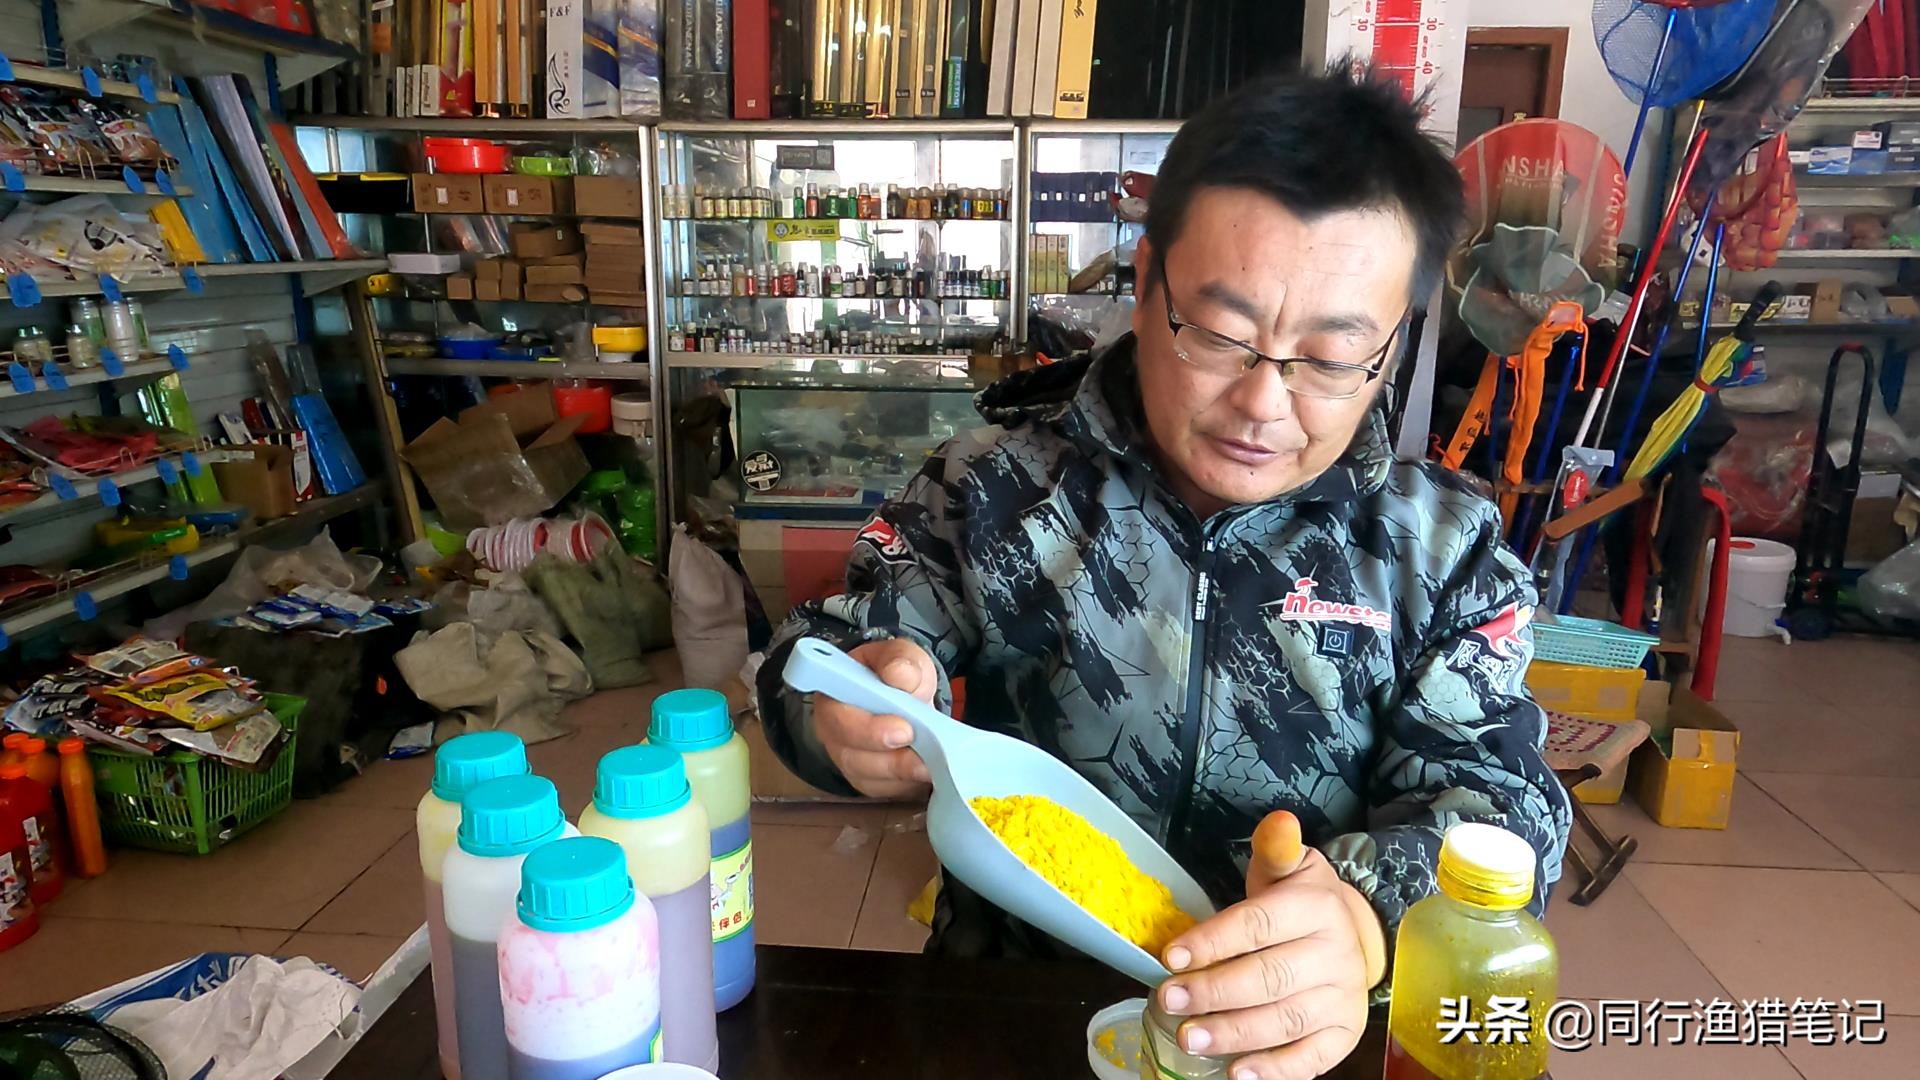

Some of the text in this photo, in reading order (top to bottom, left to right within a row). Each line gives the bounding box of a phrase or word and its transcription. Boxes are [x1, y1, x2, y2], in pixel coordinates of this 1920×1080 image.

[1357, 18, 1369, 32] 30
[1426, 17, 1438, 31] 30
[1422, 60, 1433, 75] 40
